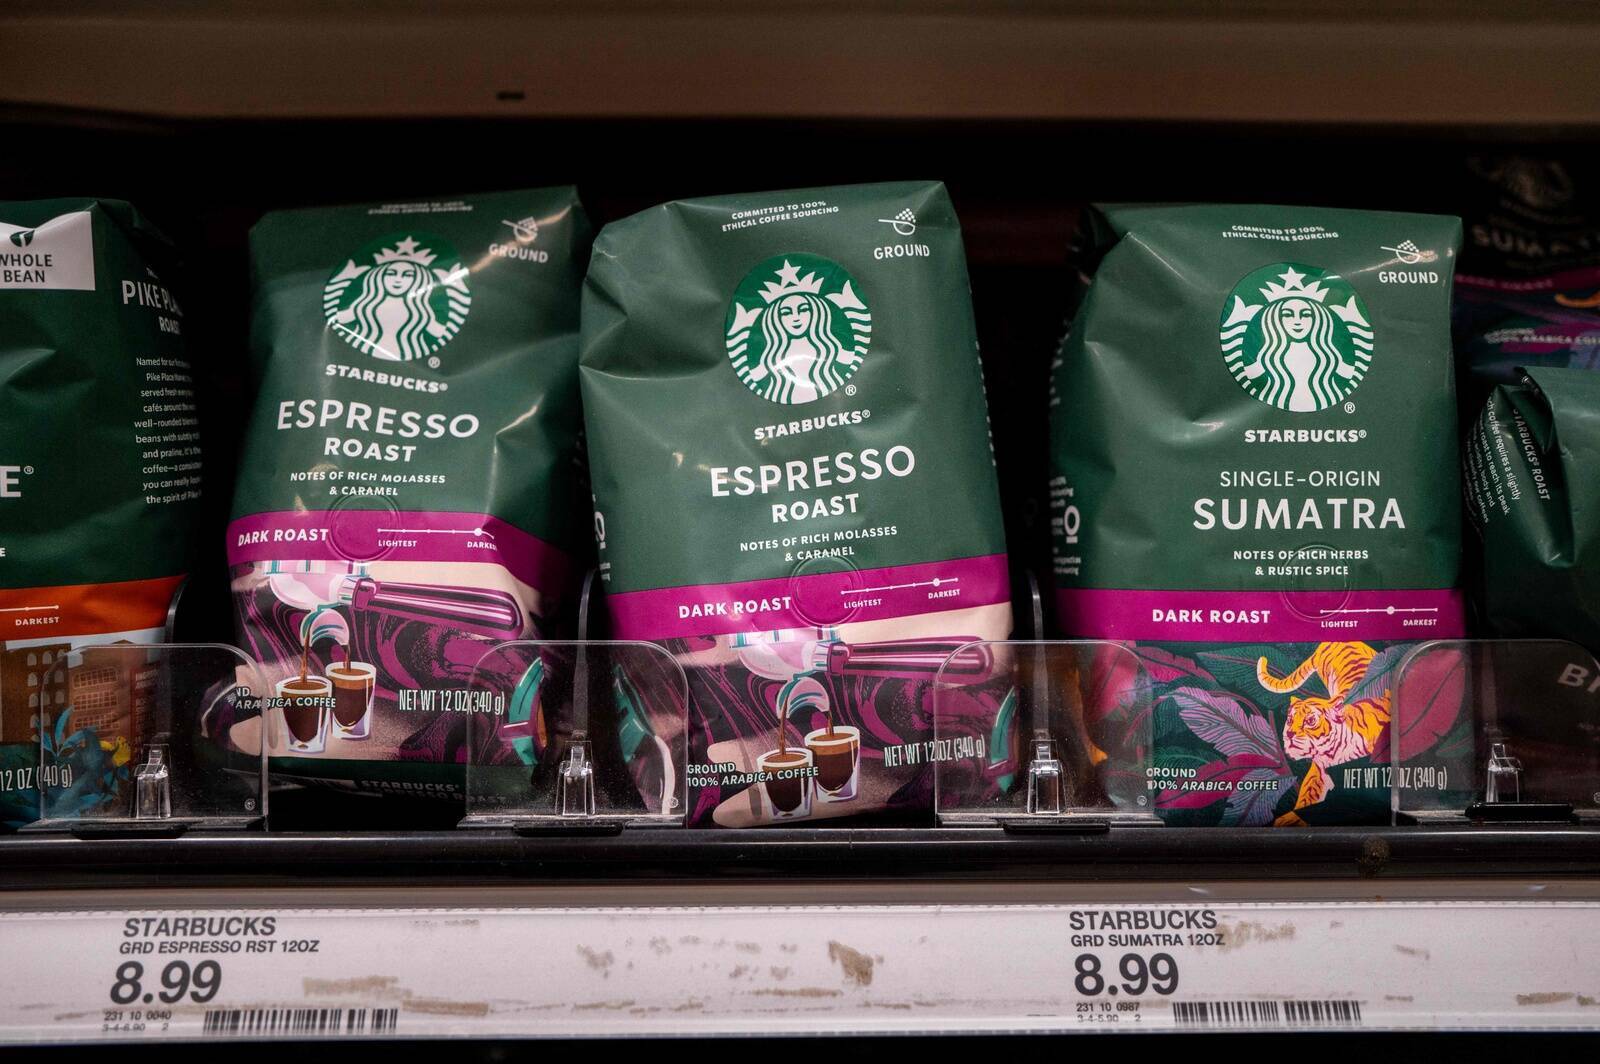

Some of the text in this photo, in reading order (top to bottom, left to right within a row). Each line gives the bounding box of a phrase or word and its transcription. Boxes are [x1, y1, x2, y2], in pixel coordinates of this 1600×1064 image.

[732, 206, 785, 220] COMMITTED
[801, 200, 827, 208] 100%
[721, 206, 840, 232] ETHICAL COFFEE SOURCING
[1232, 225, 1283, 235] COMMITTED
[1260, 233, 1290, 242] COFFEE
[1292, 232, 1339, 241] SOURCING
[489, 242, 550, 263] GROUND
[873, 244, 930, 260] GROUND
[0, 254, 53, 267] WHOLE
[4, 270, 46, 283] BEAN
[1378, 270, 1439, 284] GROUND
[121, 279, 162, 309] PIKE
[136, 357, 160, 367] Named
[146, 372, 161, 382] Pike
[140, 388, 165, 398] served
[143, 403, 163, 413] cafés
[277, 399, 480, 438] ESPRESSO
[1488, 411, 1501, 435] coffee
[136, 434, 162, 444] beans
[142, 448, 159, 459] and
[324, 437, 417, 463] ROAST
[1494, 432, 1510, 467] requires
[290, 470, 446, 484] NOTES OF RICH MOLASSES
[710, 445, 916, 497] ESPRESSO
[142, 481, 159, 492] you
[160, 480, 173, 488] can
[1219, 471, 1381, 488] SINGLE-ORIGIN
[1485, 454, 1492, 462] to
[1489, 461, 1500, 483] reach
[1498, 493, 1510, 515] peak
[1506, 471, 1522, 500] slightly
[1531, 468, 1551, 500] ROAST
[330, 486, 399, 496] & CARAMEL
[146, 495, 162, 504] the
[772, 492, 860, 523] ROAST
[1192, 498, 1406, 530] SUMATRA
[238, 528, 330, 547] DARK ROAST
[378, 539, 418, 548] LIGHTEST
[740, 525, 898, 552] NOTES OF RICH MOLASSES
[785, 546, 855, 561] & CARAMEL
[1234, 550, 1369, 560] NOTES OF RICH HERBS
[1255, 566, 1350, 576] & RUSTIC SPICE
[844, 588, 961, 609] LIGHTEST DARKEST
[678, 596, 792, 618] DARK ROAST
[15, 616, 60, 626] DARKEST
[1152, 610, 1270, 624] DARK ROAST
[1320, 618, 1437, 628] LIGHTEST DARKEST
[296, 696, 337, 708] COFFEE
[399, 690, 505, 716] NET WT 12 OZ (340 g)
[884, 734, 986, 768] NET WT 12 OZ (340 g)
[688, 762, 736, 774] GROUND
[0, 764, 72, 792] 12 OZ (40 g)
[688, 766, 820, 788] 100% ARABICA COFFEE
[1344, 766, 1448, 791] NET WT 12 OZ (340 g)
[1180, 780, 1234, 791] ARABICA
[1236, 780, 1278, 790] COFFEE
[123, 916, 277, 938] STARBUCKS
[1070, 910, 1218, 930] STARBUCKS
[120, 940, 320, 955] GRD ESPRESSO RST 12OZ
[1071, 933, 1226, 948] GRD SUMATRA 12OZ
[1074, 952, 1179, 996] 8.99
[110, 960, 223, 1005] 8.99
[1076, 1002, 1140, 1012] 231 10 0987
[104, 1010, 172, 1021] 231 10 0040
[1134, 1014, 1142, 1022] 2
[162, 1023, 170, 1032] 2
